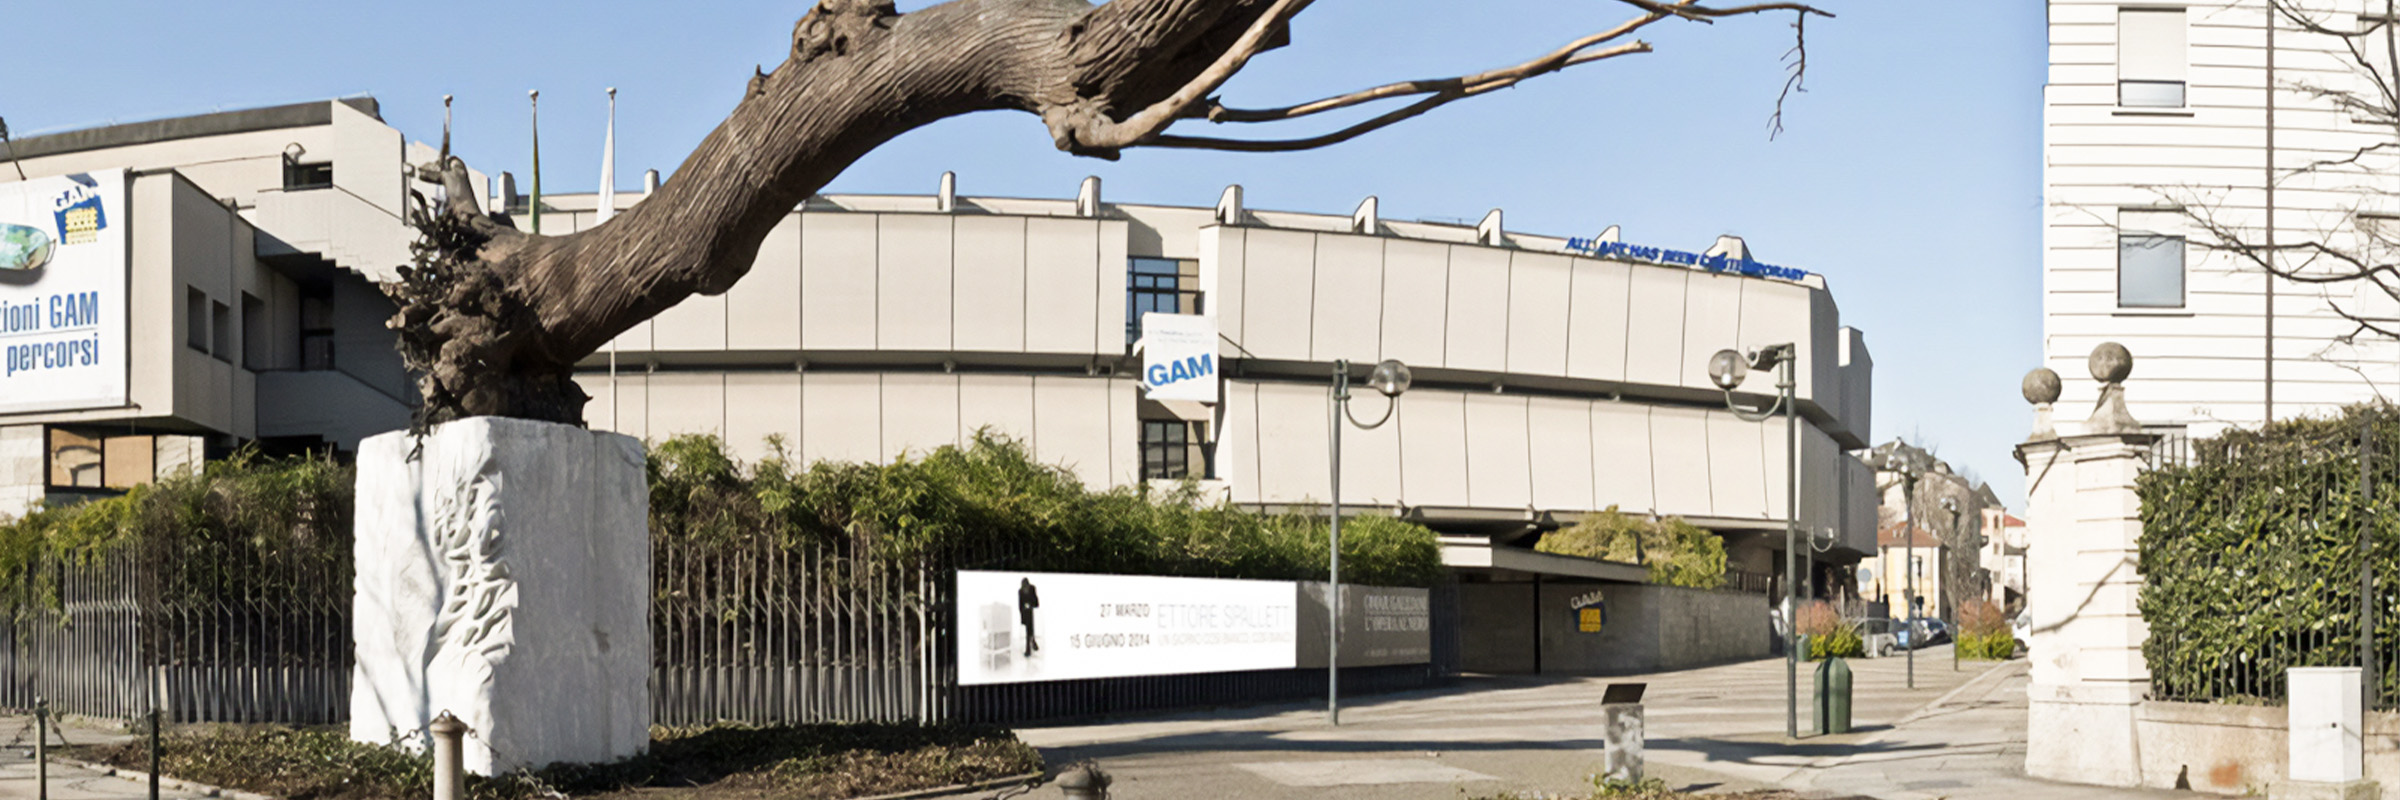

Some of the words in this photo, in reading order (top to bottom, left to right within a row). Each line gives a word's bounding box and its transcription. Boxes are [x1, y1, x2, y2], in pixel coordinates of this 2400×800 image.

[1566, 237, 1592, 251] ALL
[1630, 245, 1659, 260] HAS
[0, 297, 40, 333] ioni
[49, 291, 98, 329] GAM
[7, 333, 98, 377] percorsi
[1147, 353, 1213, 386] GAM
[1100, 603, 1112, 617] 27
[1115, 603, 1150, 617] MARZO
[1570, 590, 1604, 610] GAM
[1157, 604, 1217, 629] ETTORE
[1069, 633, 1081, 648] 15
[1084, 633, 1126, 648] GIUGNO
[1128, 633, 1150, 648] 2014
